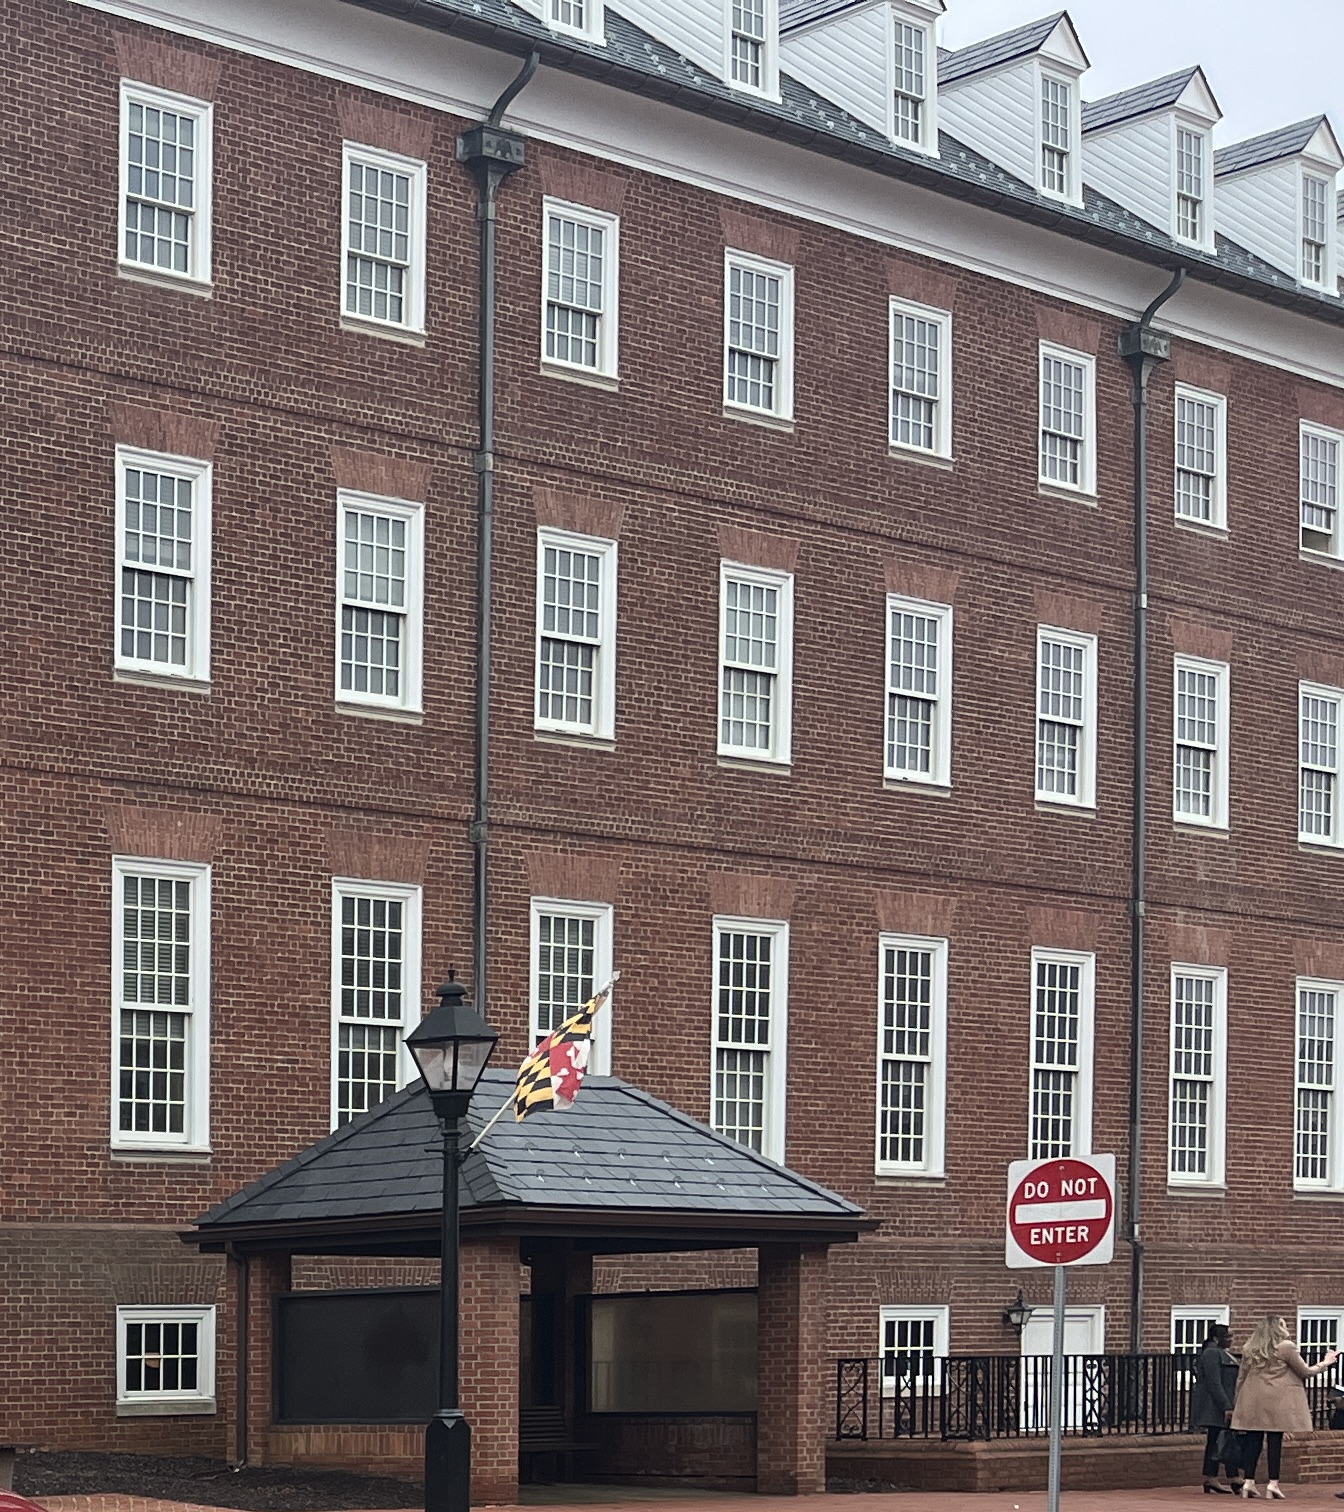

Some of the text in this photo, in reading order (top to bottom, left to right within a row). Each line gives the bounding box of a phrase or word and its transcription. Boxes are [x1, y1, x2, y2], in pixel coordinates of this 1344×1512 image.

[1024, 1177, 1098, 1199] DO NOT
[1030, 1225, 1089, 1245] ENTER
